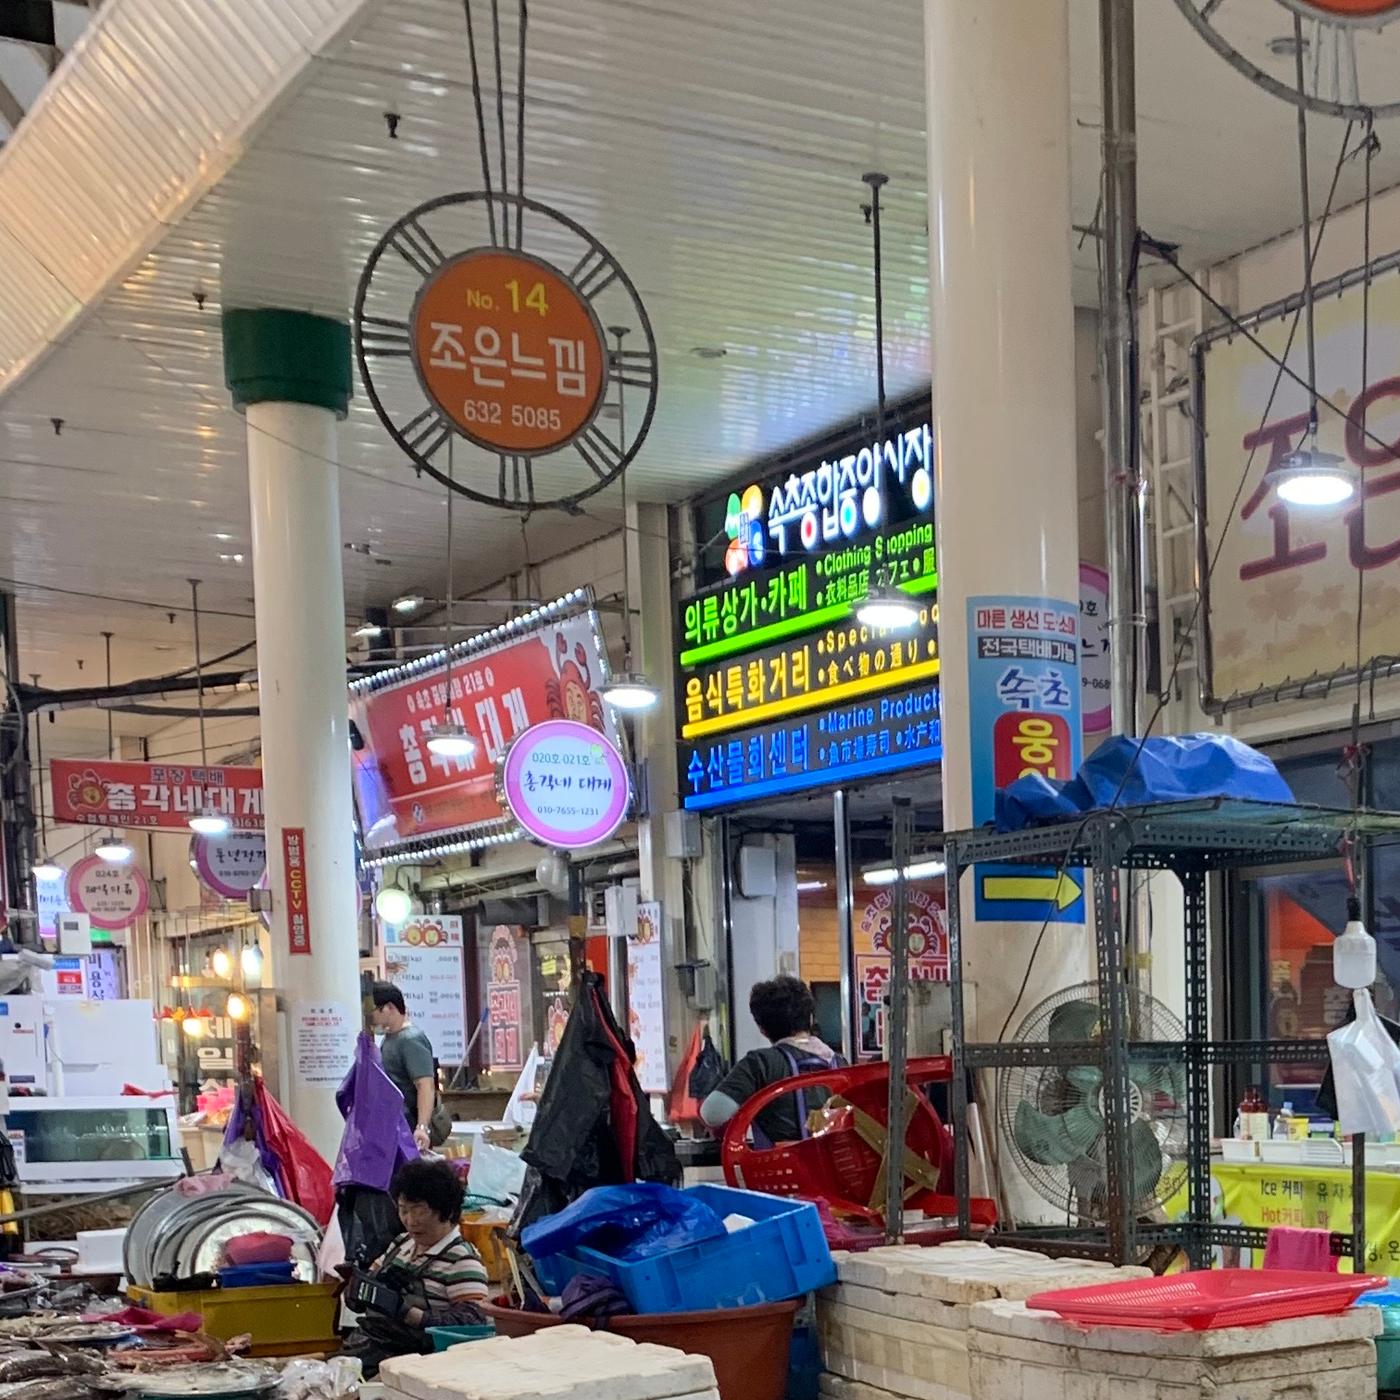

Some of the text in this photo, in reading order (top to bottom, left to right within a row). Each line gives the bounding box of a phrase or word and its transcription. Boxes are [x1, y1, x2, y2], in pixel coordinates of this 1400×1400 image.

[466, 280, 550, 317] No. 14
[429, 321, 586, 398] 조은느낌
[463, 399, 561, 430] 632 5085
[823, 544, 872, 576] Clothing
[977, 608, 1006, 629] 마른
[1010, 609, 1040, 631] 생선
[686, 645, 809, 722] 음식특화거리
[1000, 669, 1069, 709] 속초
[828, 707, 874, 733] Marine
[688, 723, 808, 794] 수산물회센터
[524, 770, 613, 792] 총각네 대게
[290, 869, 302, 910] CCTV
[1261, 1179, 1277, 1196] Ice
[1282, 1180, 1303, 1200] 커피
